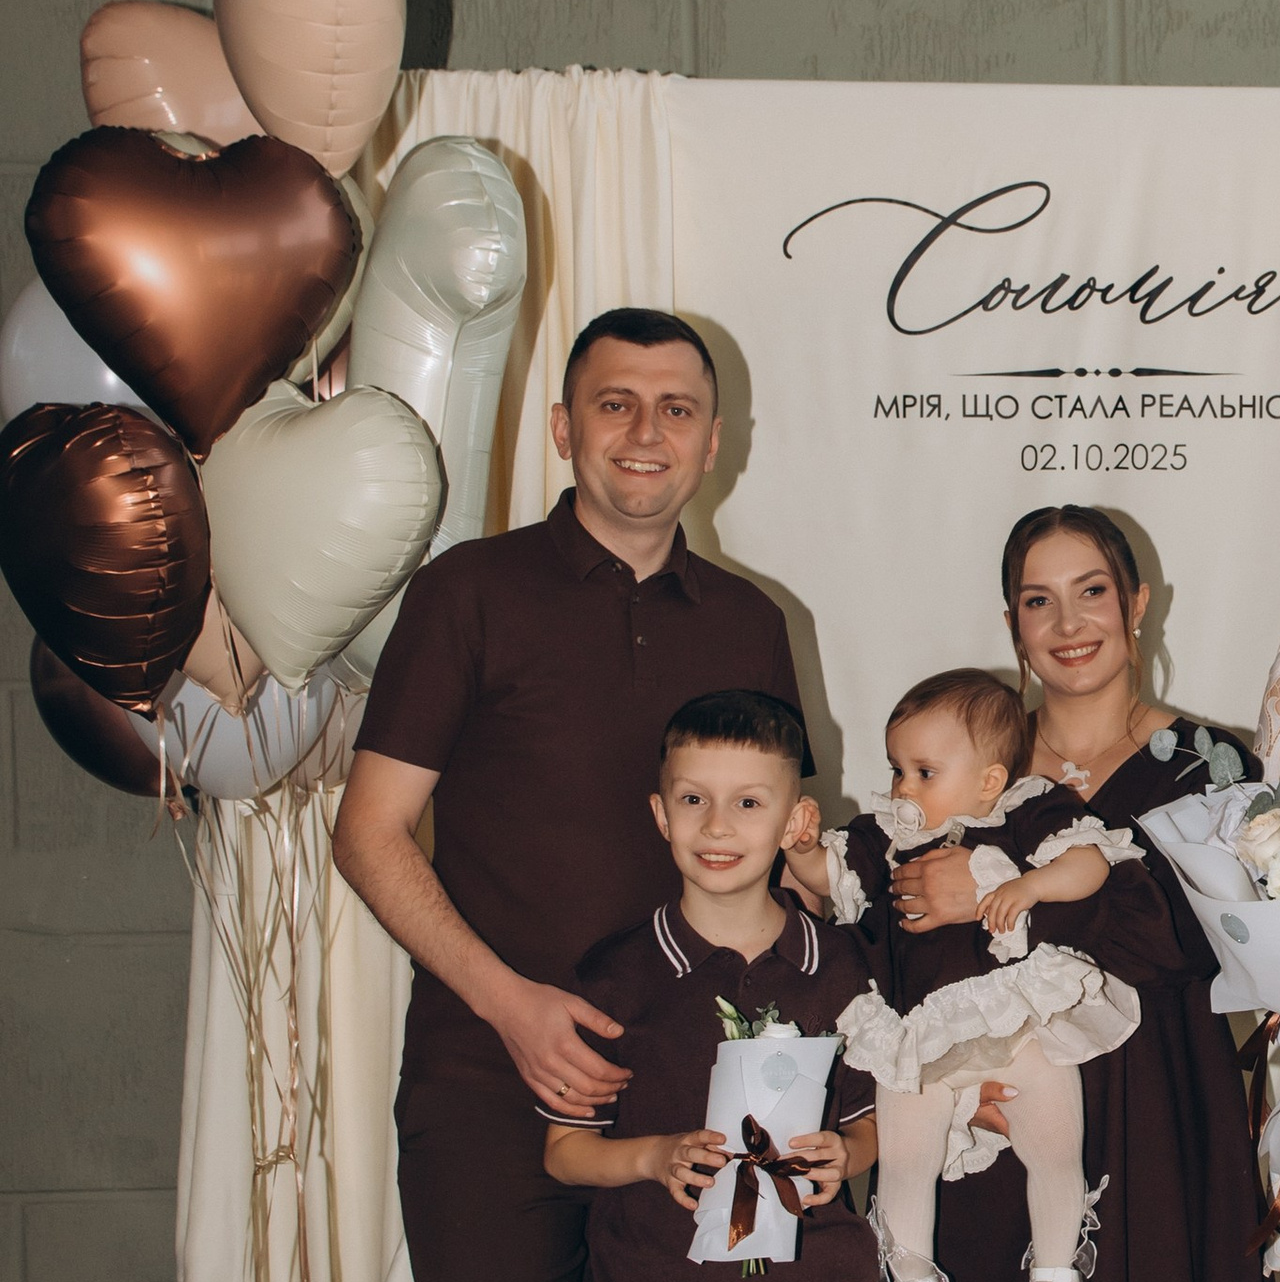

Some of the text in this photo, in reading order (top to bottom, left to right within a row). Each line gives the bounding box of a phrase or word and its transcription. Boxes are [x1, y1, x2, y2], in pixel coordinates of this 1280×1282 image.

[873, 393, 951, 422] МРІЯ,
[961, 393, 1020, 422] ЩО
[1030, 393, 1131, 420] СТАЛА
[1020, 442, 1188, 472] 02.10.2025
